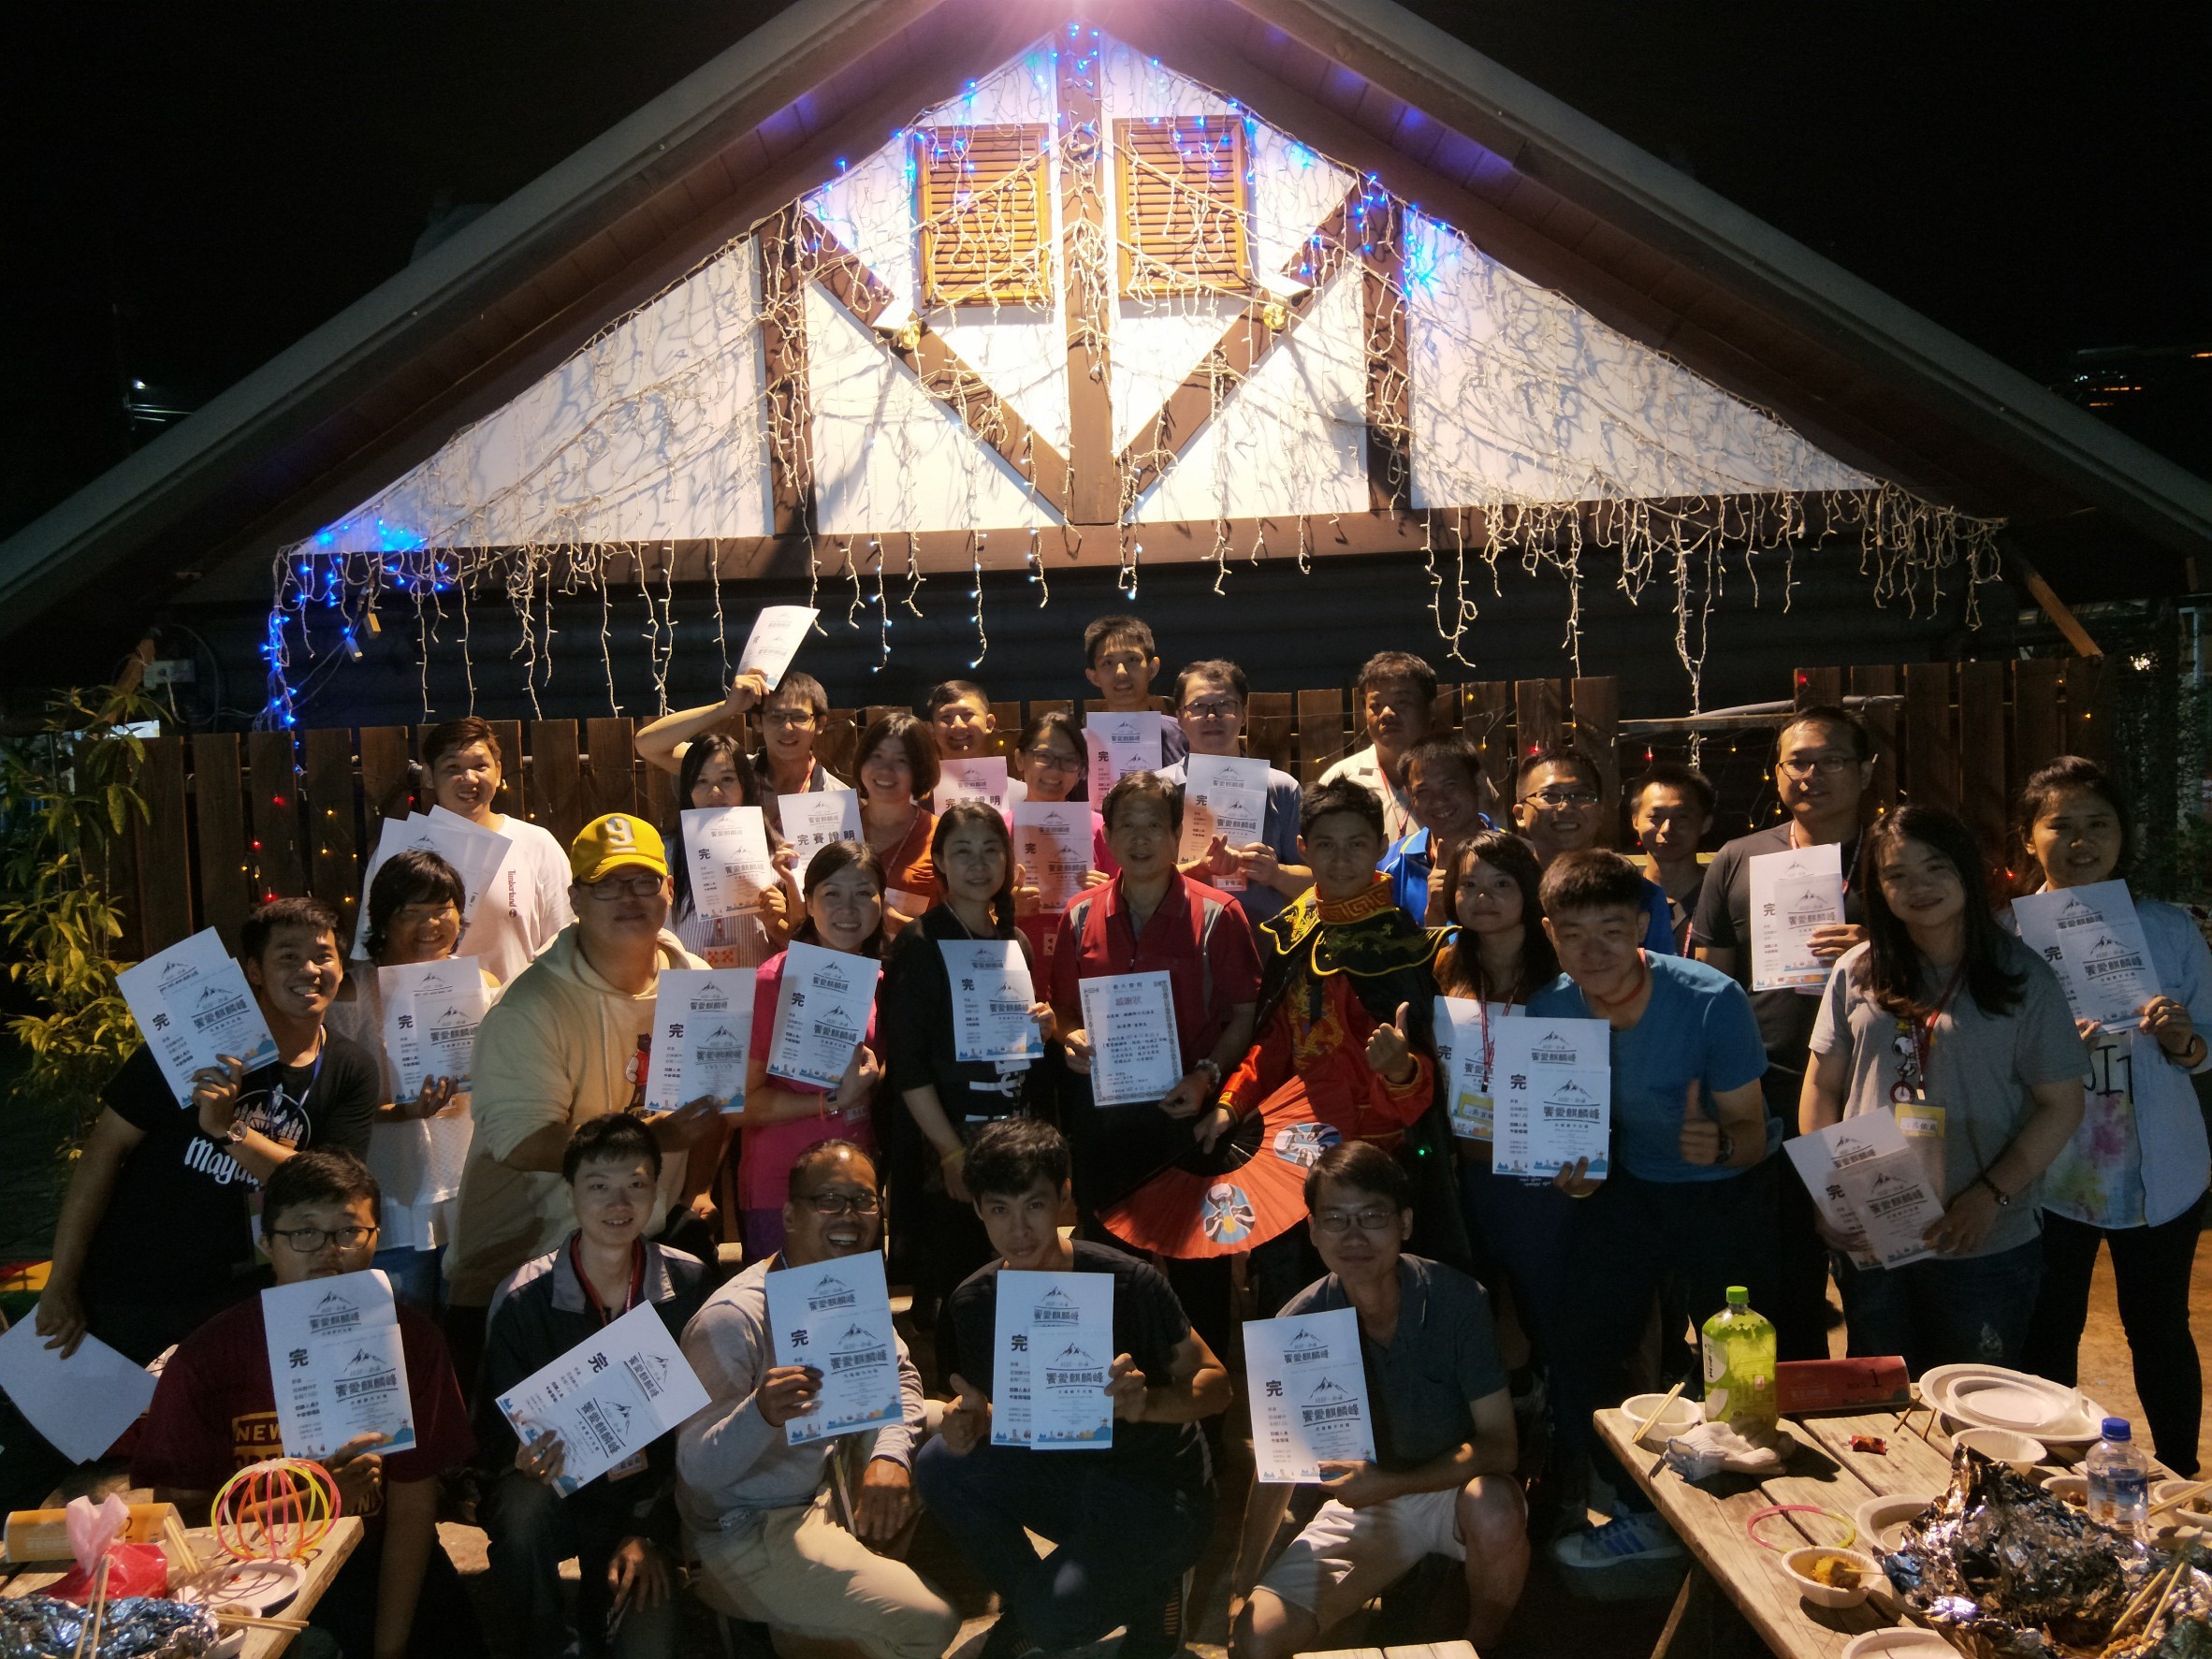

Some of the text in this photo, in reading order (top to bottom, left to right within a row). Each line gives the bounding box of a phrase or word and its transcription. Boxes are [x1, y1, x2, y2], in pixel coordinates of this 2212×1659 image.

[1196, 794, 1208, 807] 完
[604, 816, 635, 845] 9
[797, 829, 855, 846] 完賽證明
[698, 848, 711, 861] 完
[1763, 903, 1776, 917] 完
[2044, 946, 2063, 963] 完
[962, 978, 975, 992] 完
[792, 992, 806, 1008] 完
[152, 1012, 170, 1031] 完
[399, 1014, 414, 1030] 完
[668, 1023, 684, 1039] 完
[1510, 1074, 1527, 1090] 完
[1826, 1185, 1845, 1201] 完
[791, 1329, 809, 1347] 完
[1011, 1334, 1028, 1352] 完
[288, 1347, 309, 1369] 完
[588, 1352, 609, 1374] 完
[1265, 1379, 1284, 1398] 完
